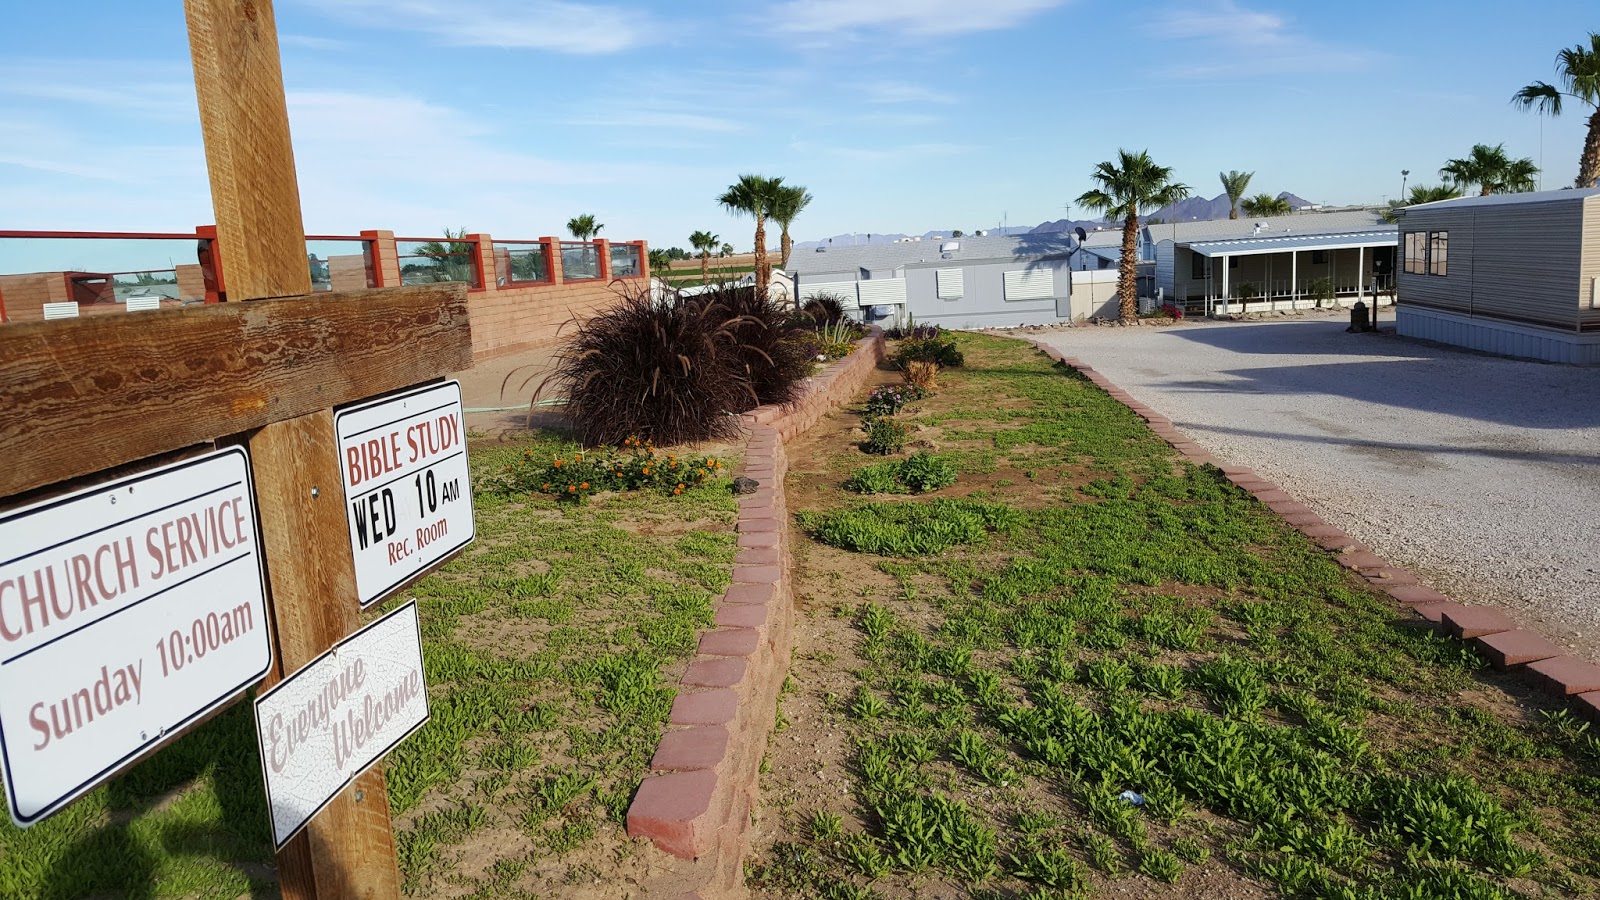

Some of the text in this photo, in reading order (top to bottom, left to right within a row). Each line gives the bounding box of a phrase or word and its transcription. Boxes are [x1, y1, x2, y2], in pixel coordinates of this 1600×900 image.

[347, 412, 459, 487] BIBLE STUDY
[353, 469, 460, 551] WED 10 AM
[387, 518, 448, 566] Rec. Room
[0, 496, 248, 642] CHURCH SERVICE
[28, 601, 254, 751] Sunday 10:00am
[269, 657, 366, 773] Everyone
[333, 669, 420, 770] Welcome
